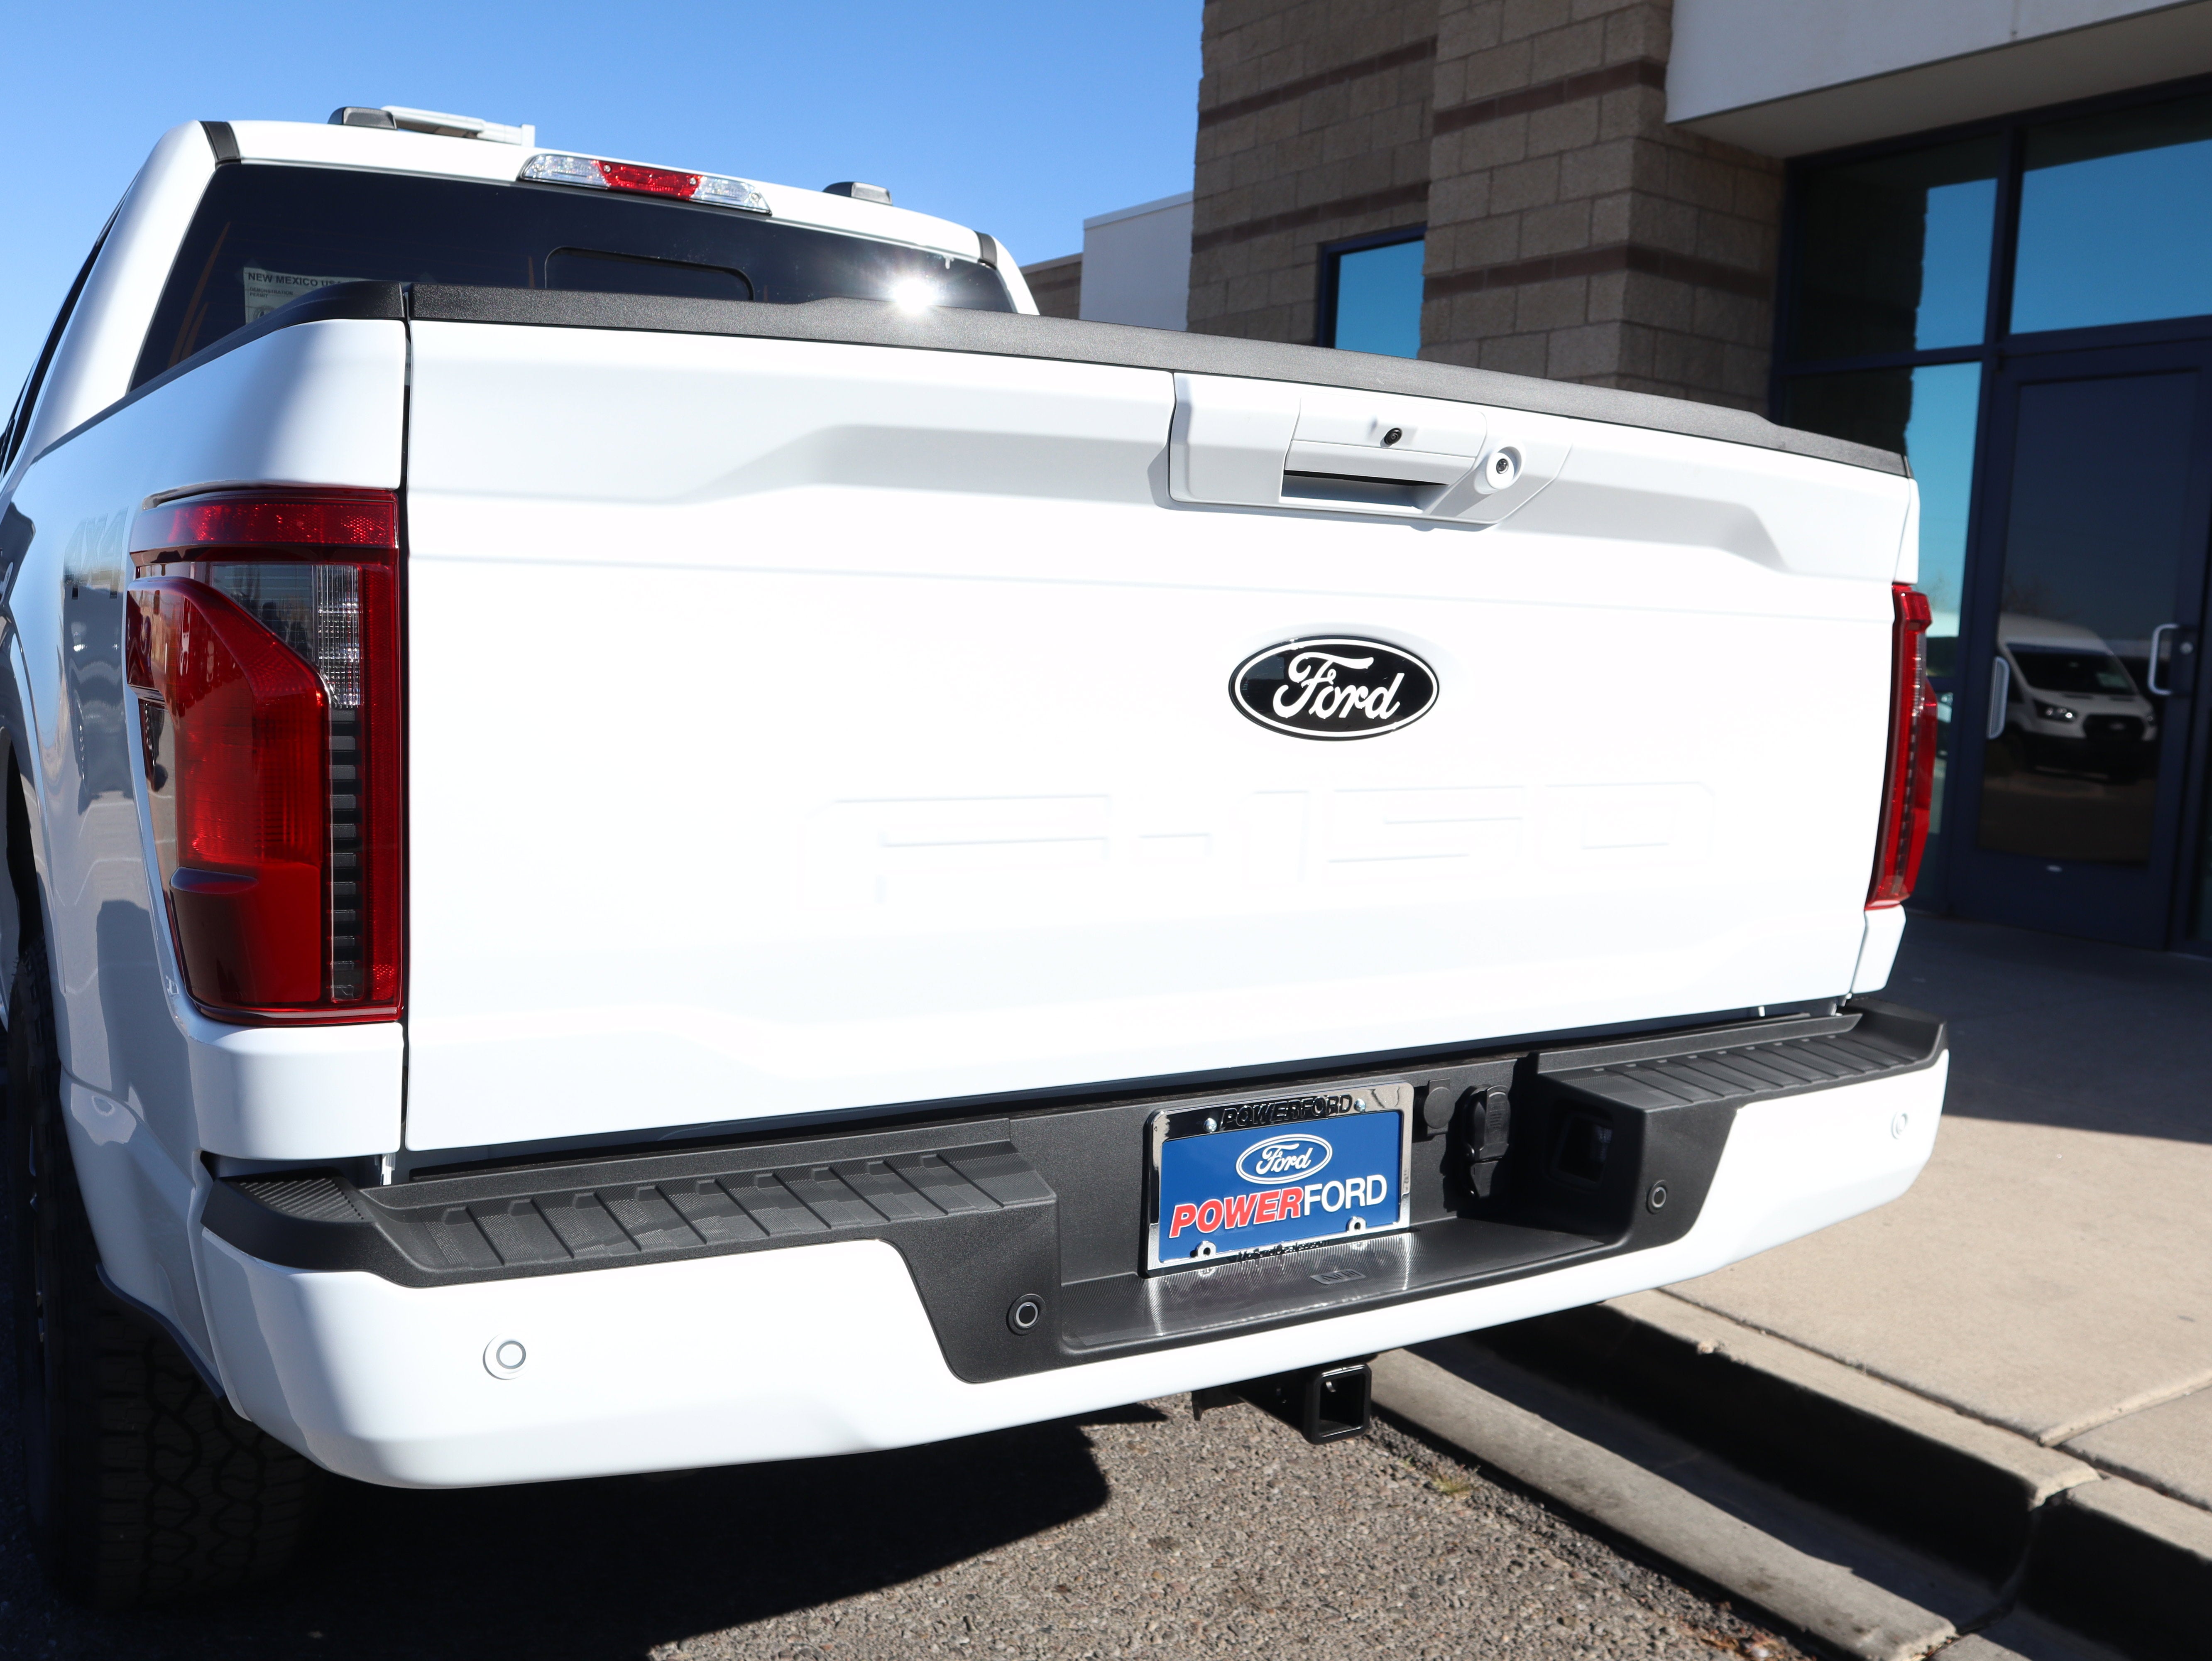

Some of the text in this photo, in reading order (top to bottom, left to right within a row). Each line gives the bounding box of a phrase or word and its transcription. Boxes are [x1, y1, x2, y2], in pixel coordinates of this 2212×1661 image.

[248, 272, 273, 283] NEW
[276, 276, 318, 287] MEXICO
[1273, 652, 1405, 719] Ford
[796, 780, 1716, 911] F-150
[1219, 1094, 1353, 1132] POWERFORD
[1255, 1143, 1313, 1175] Ford
[1169, 1174, 1387, 1239] POWERFORD
